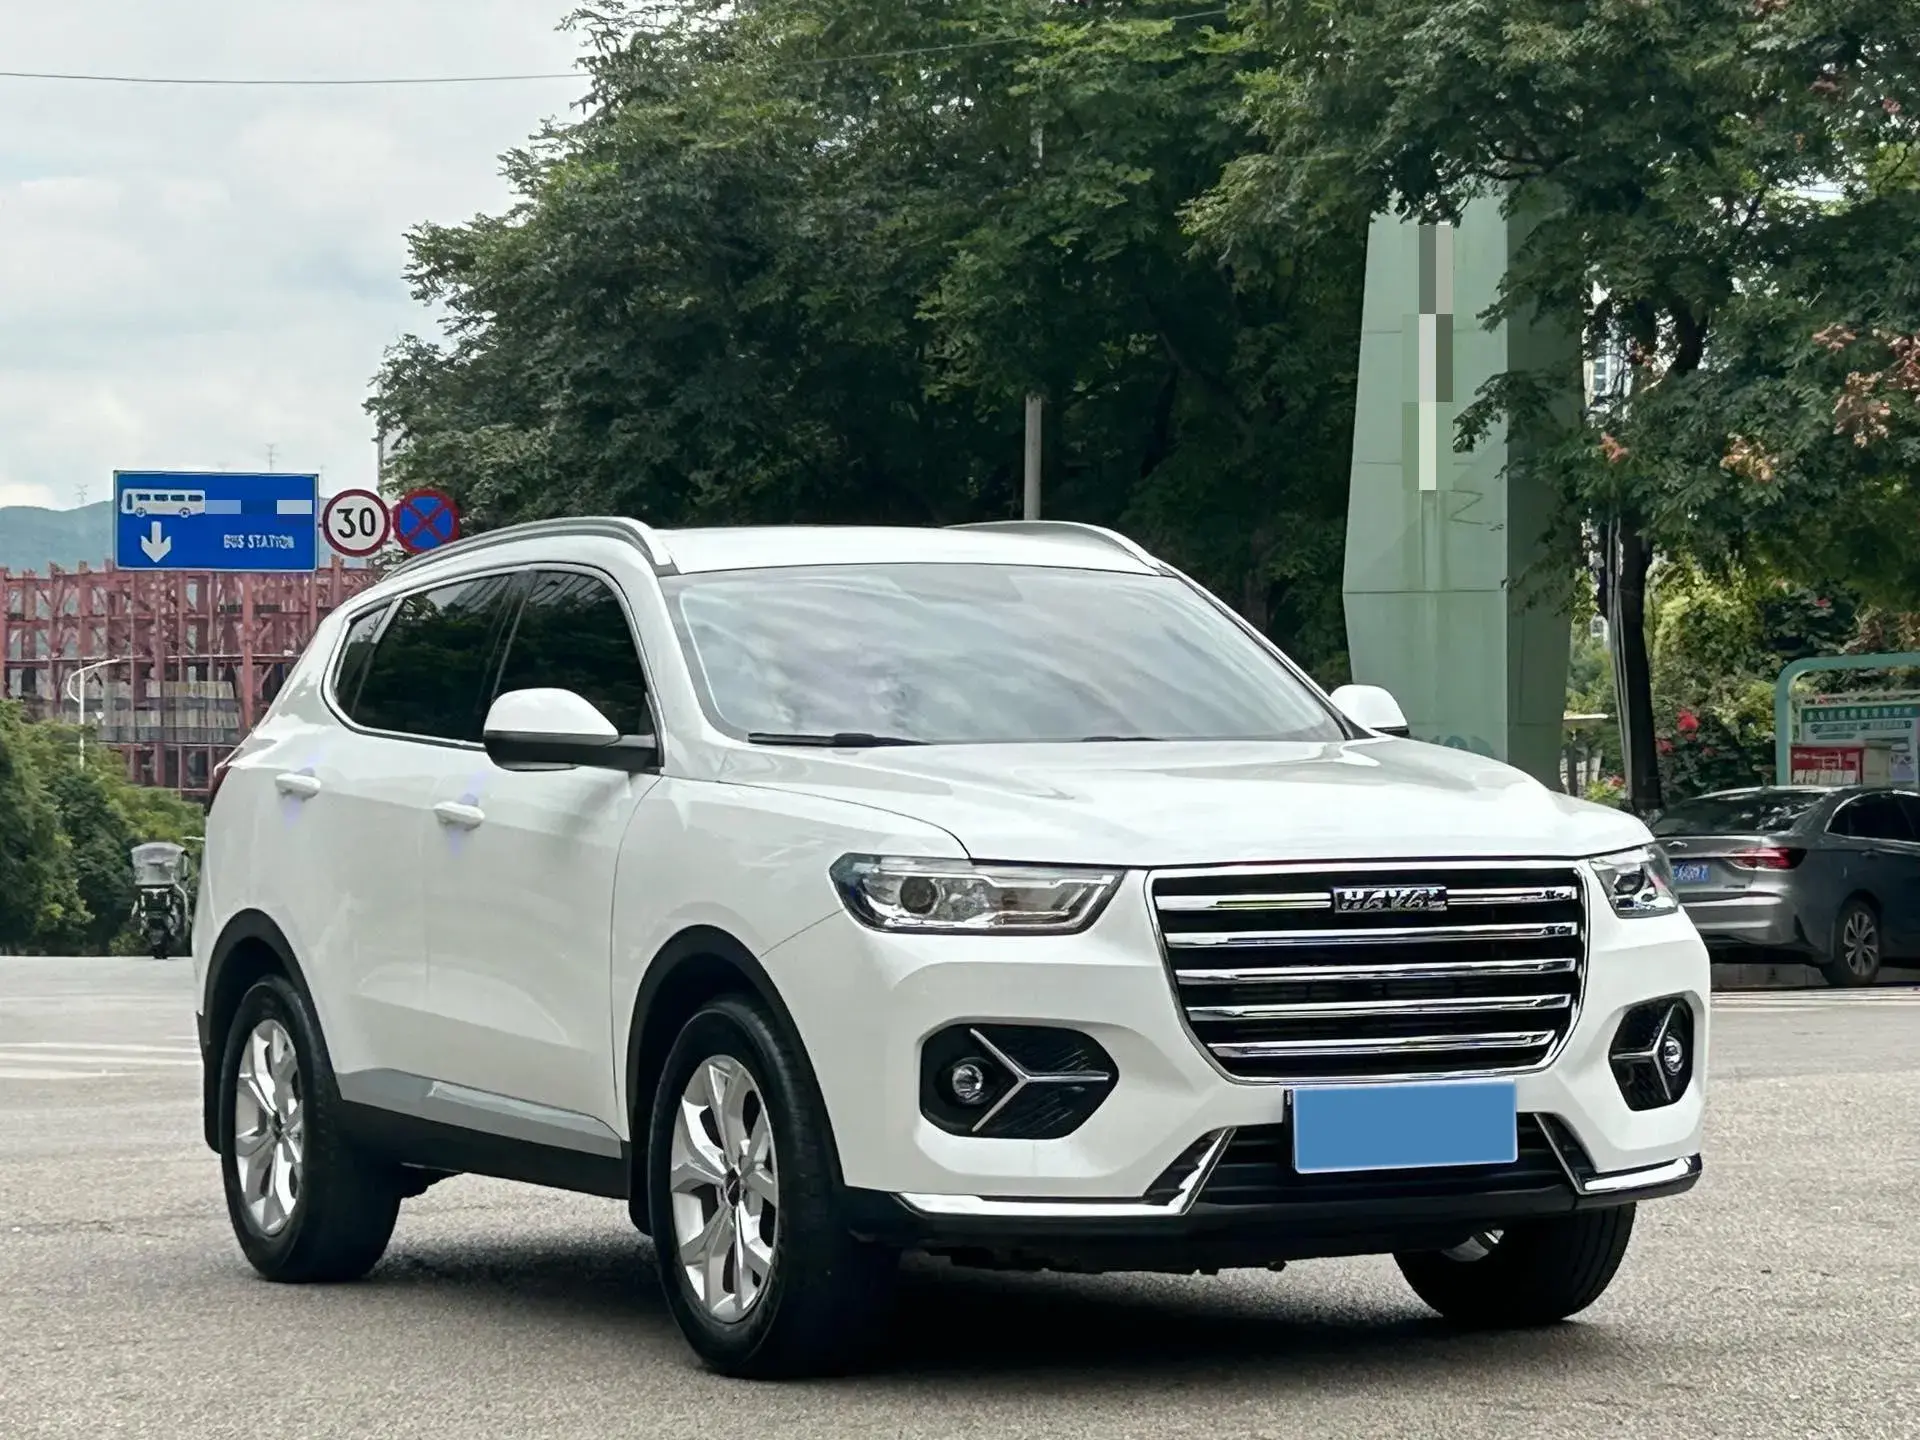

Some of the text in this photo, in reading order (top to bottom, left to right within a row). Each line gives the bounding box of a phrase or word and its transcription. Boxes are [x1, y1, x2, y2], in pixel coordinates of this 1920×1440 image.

[337, 507, 376, 539] 30
[223, 534, 295, 549] BUS STATION
